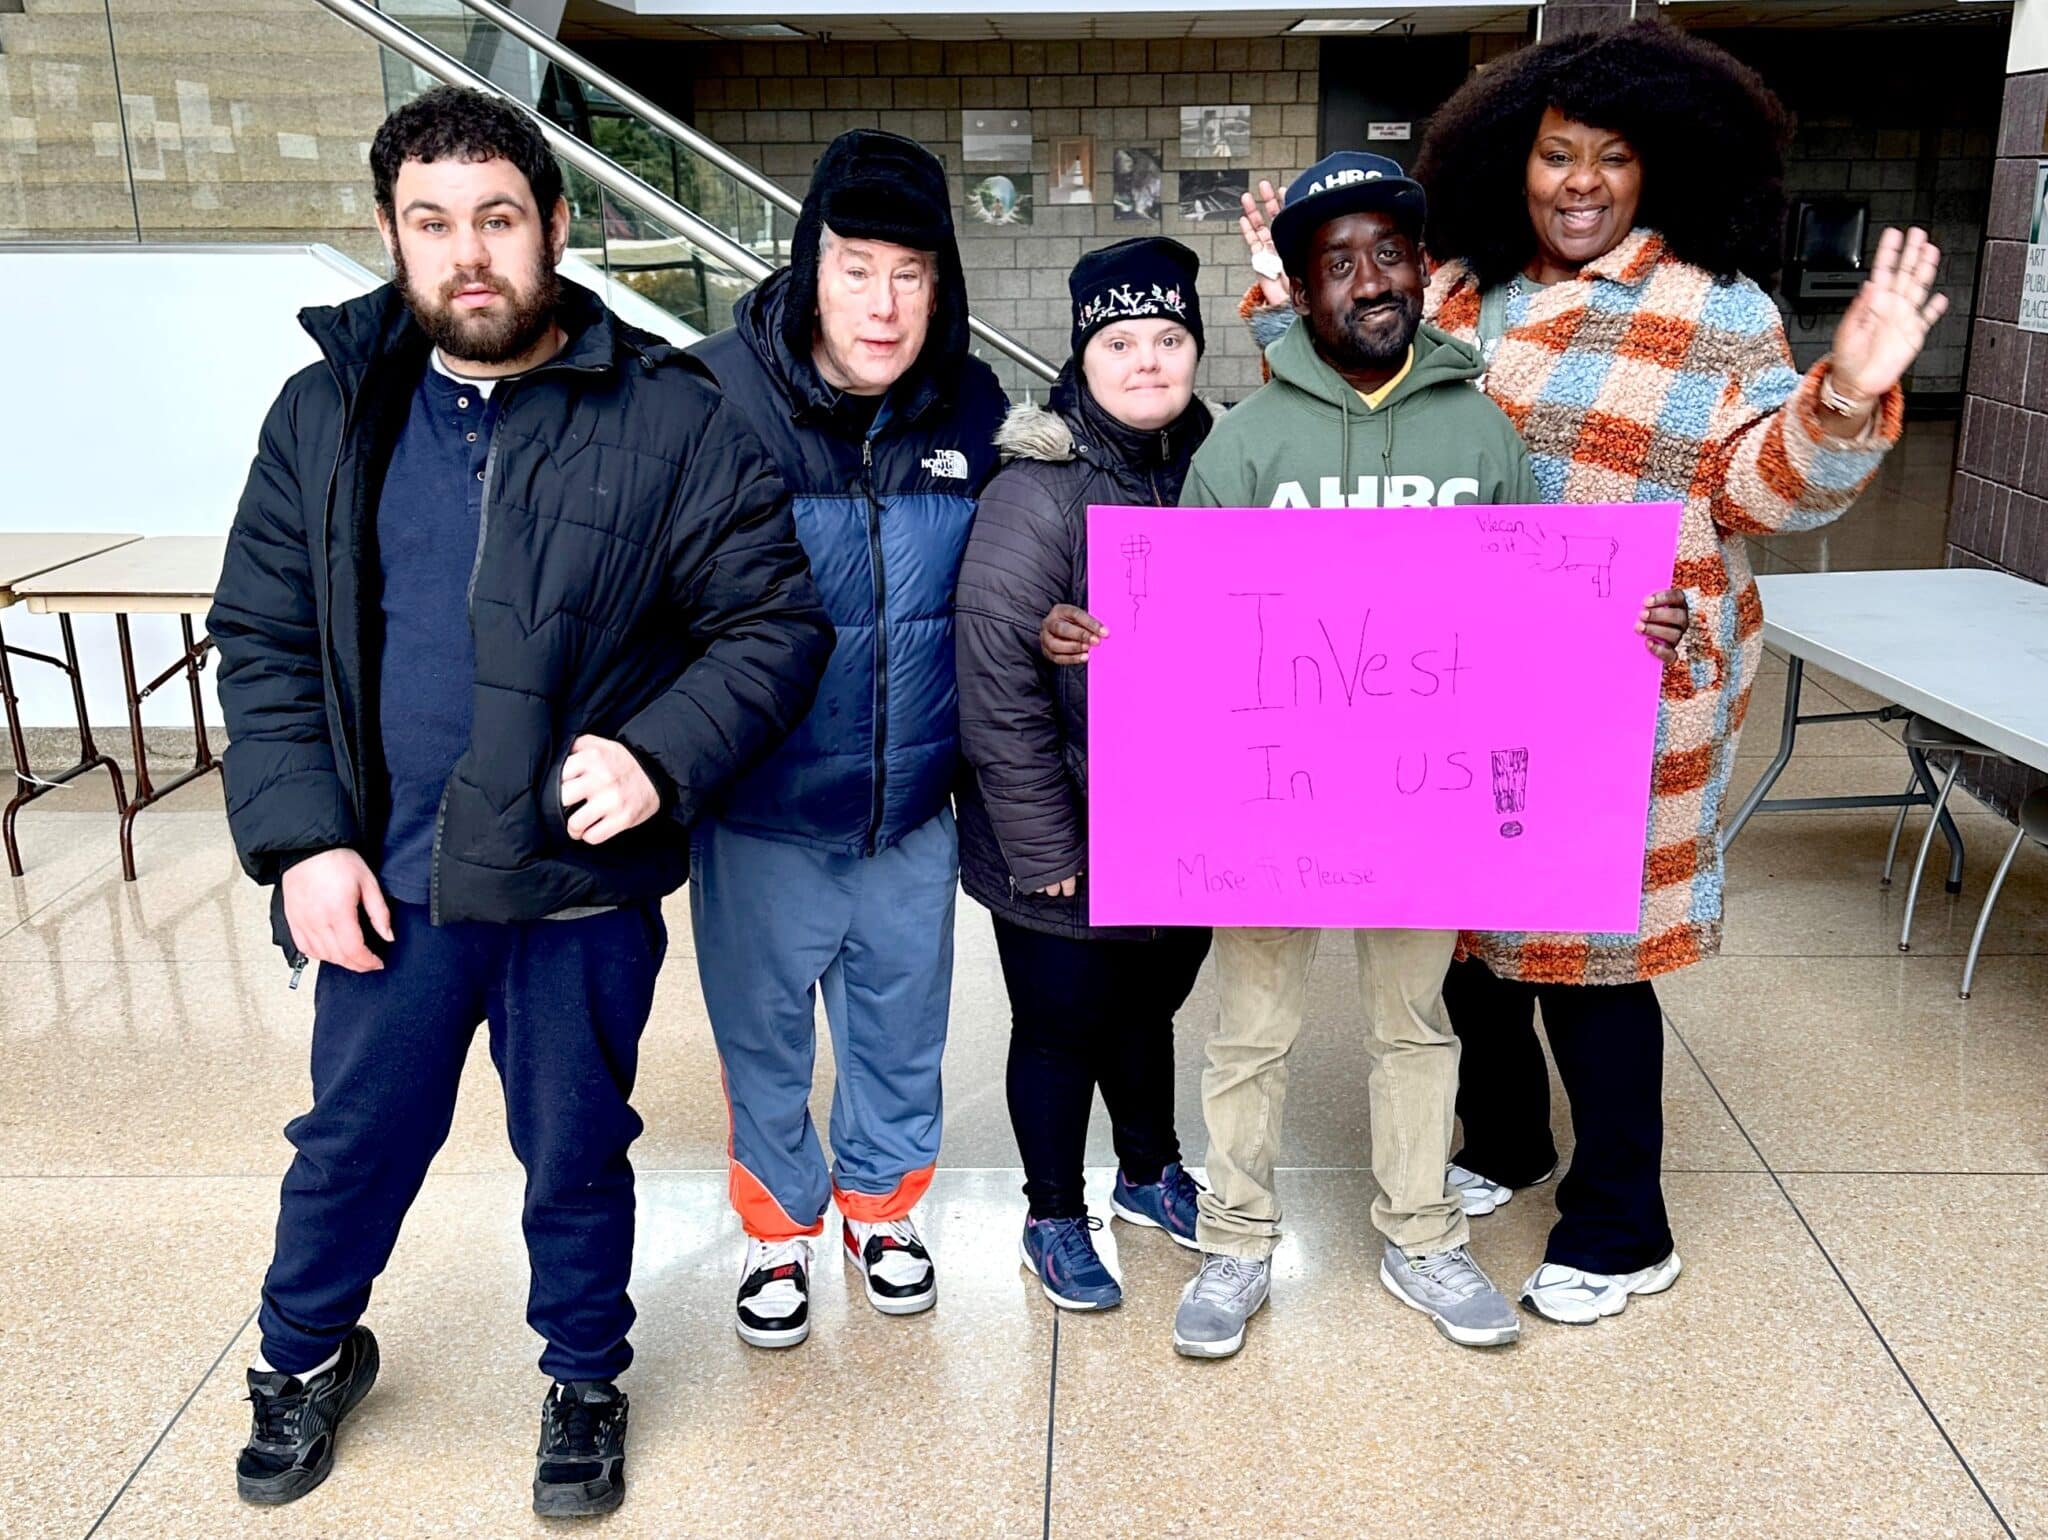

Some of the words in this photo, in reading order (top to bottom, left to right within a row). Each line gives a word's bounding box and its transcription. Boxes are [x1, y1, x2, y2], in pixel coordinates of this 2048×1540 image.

[2029, 247, 2046, 267] ART
[1241, 744, 1314, 805] In
[1296, 855, 1377, 889] Please
